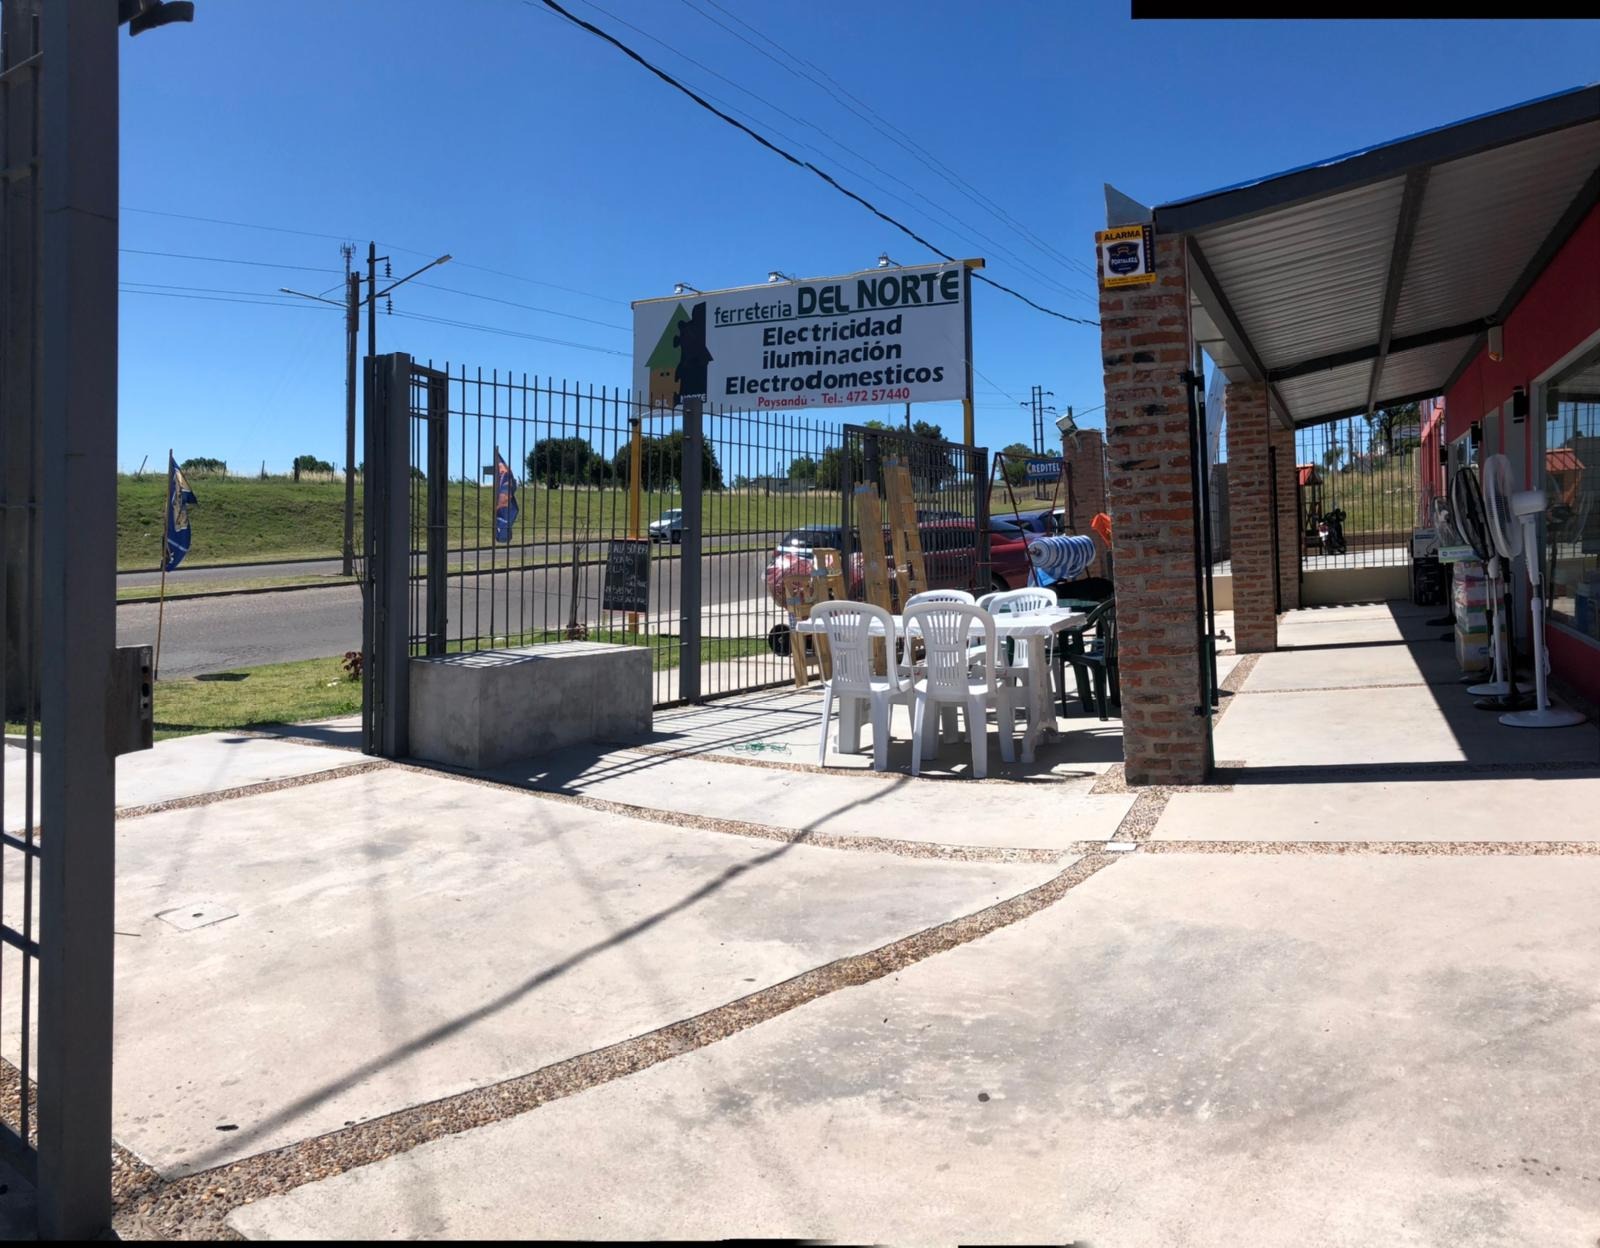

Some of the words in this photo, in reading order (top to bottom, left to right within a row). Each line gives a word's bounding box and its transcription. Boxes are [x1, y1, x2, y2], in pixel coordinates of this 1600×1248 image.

[1104, 230, 1141, 241] ALARMA
[714, 300, 792, 325] ferreteria
[798, 284, 849, 315] DEL
[857, 269, 959, 309] NORTE
[763, 314, 903, 347] Electricidad
[763, 341, 902, 370] iluminación
[725, 364, 944, 396] Electrodomesticos
[847, 390, 868, 403] 472
[872, 387, 910, 401] 57440
[1026, 462, 1061, 473] CREDITEL
